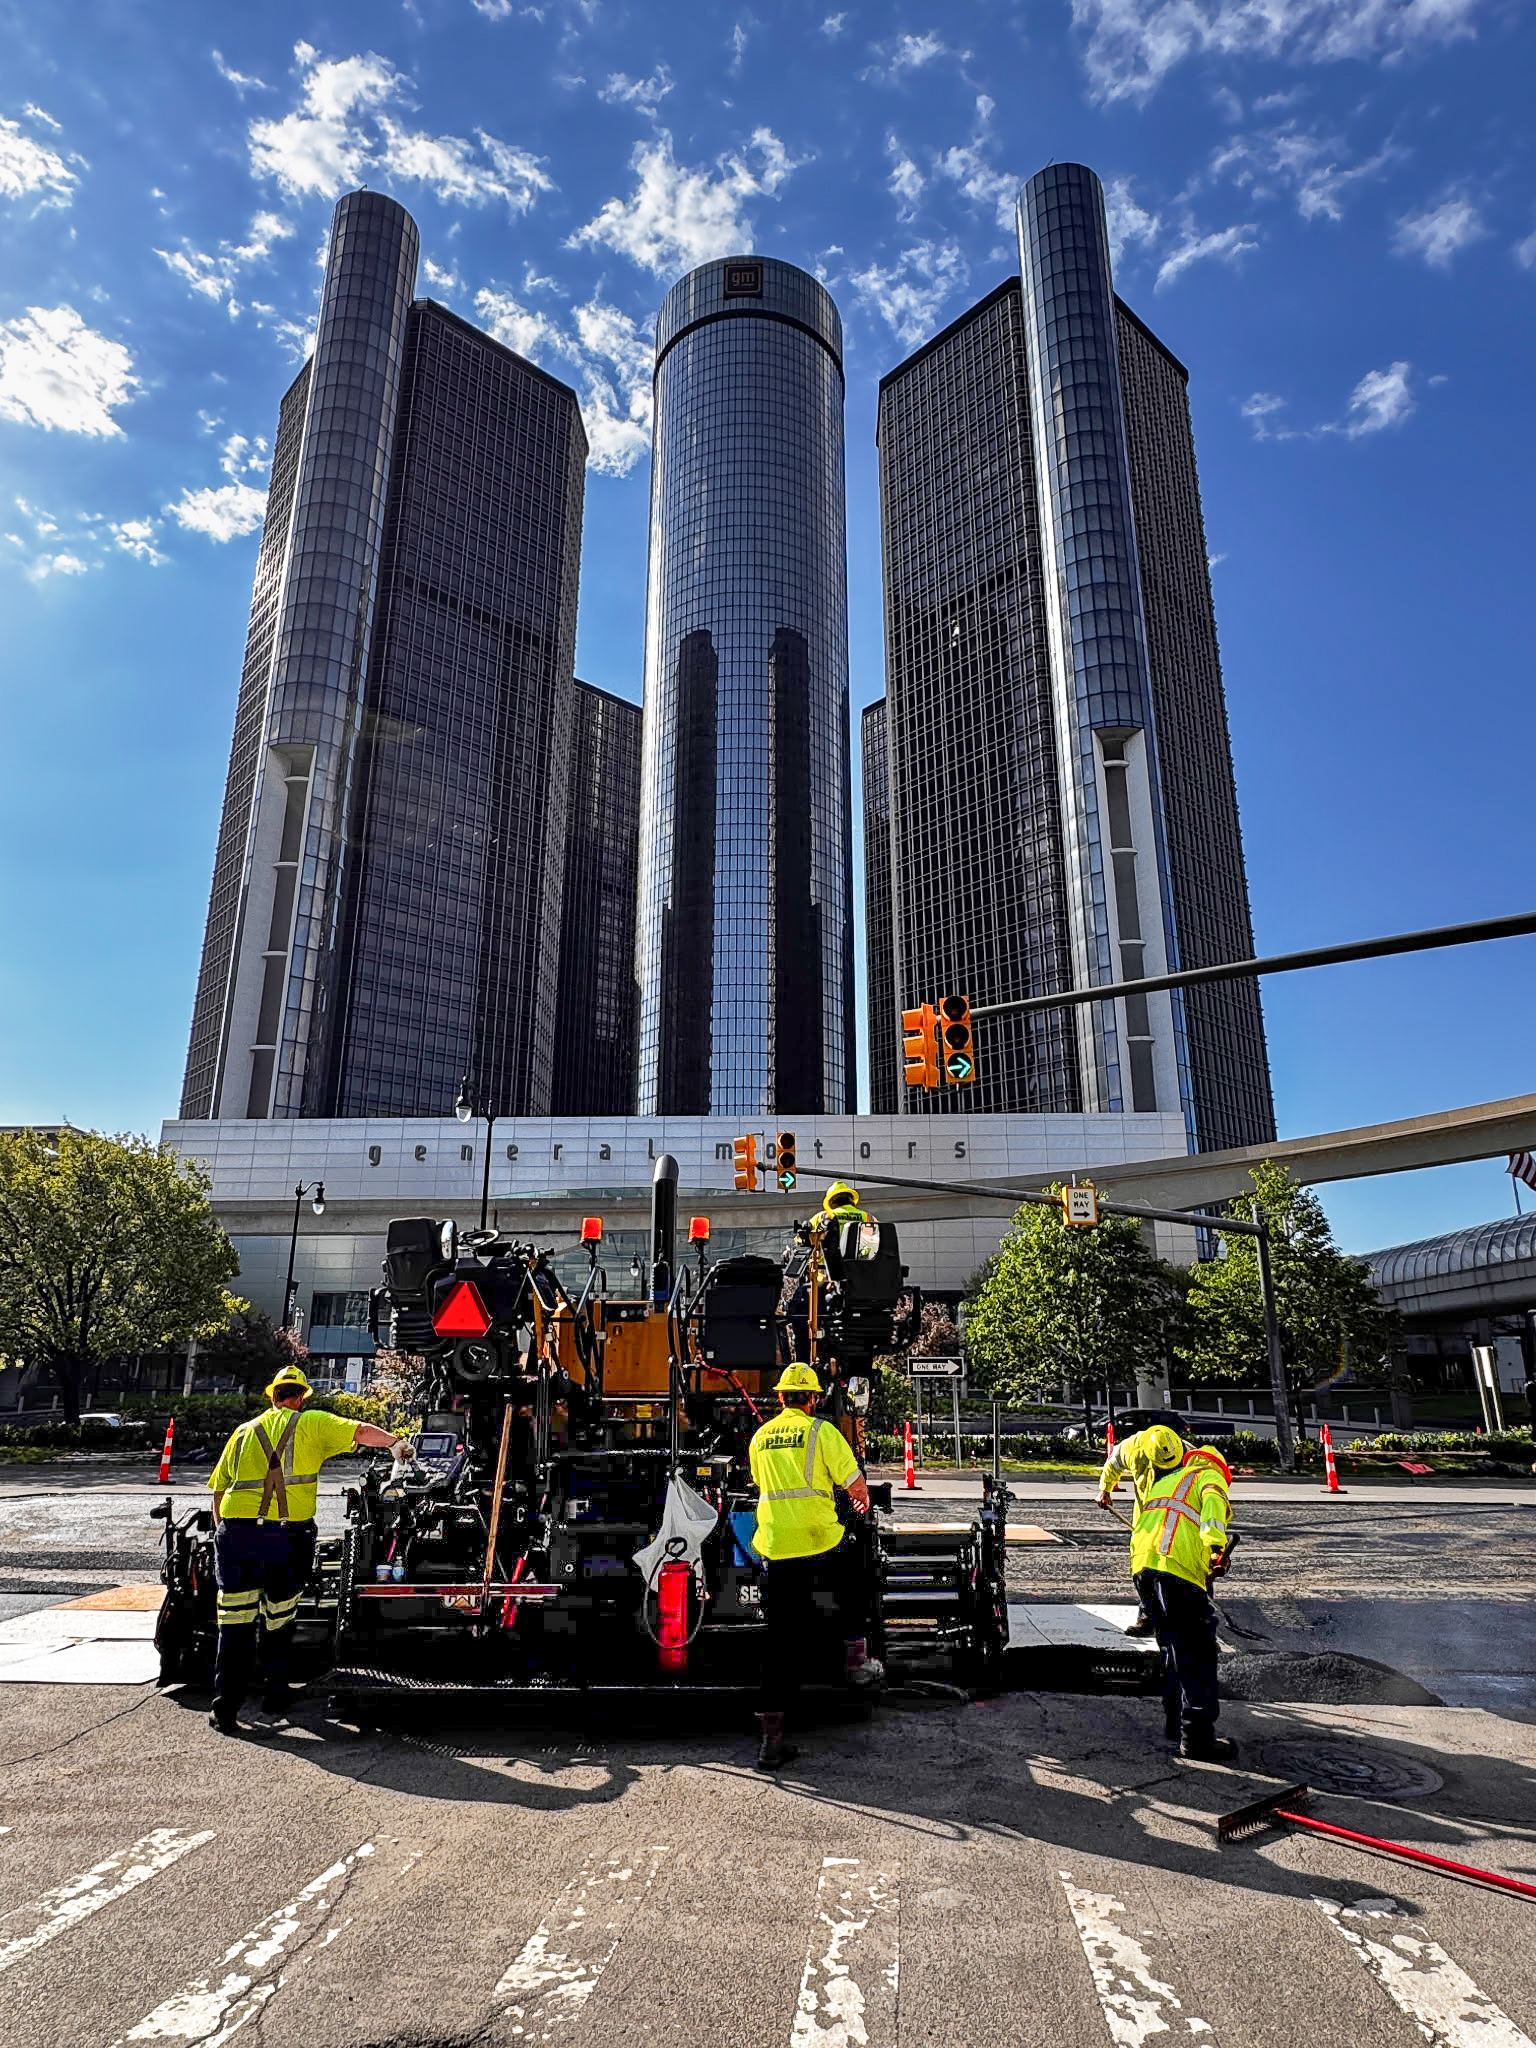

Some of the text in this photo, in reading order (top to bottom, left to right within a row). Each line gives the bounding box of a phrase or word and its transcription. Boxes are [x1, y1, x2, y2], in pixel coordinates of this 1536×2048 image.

[731, 271, 755, 286] gm
[368, 1138, 966, 1167] general motors
[1073, 1191, 1089, 1199] ONE
